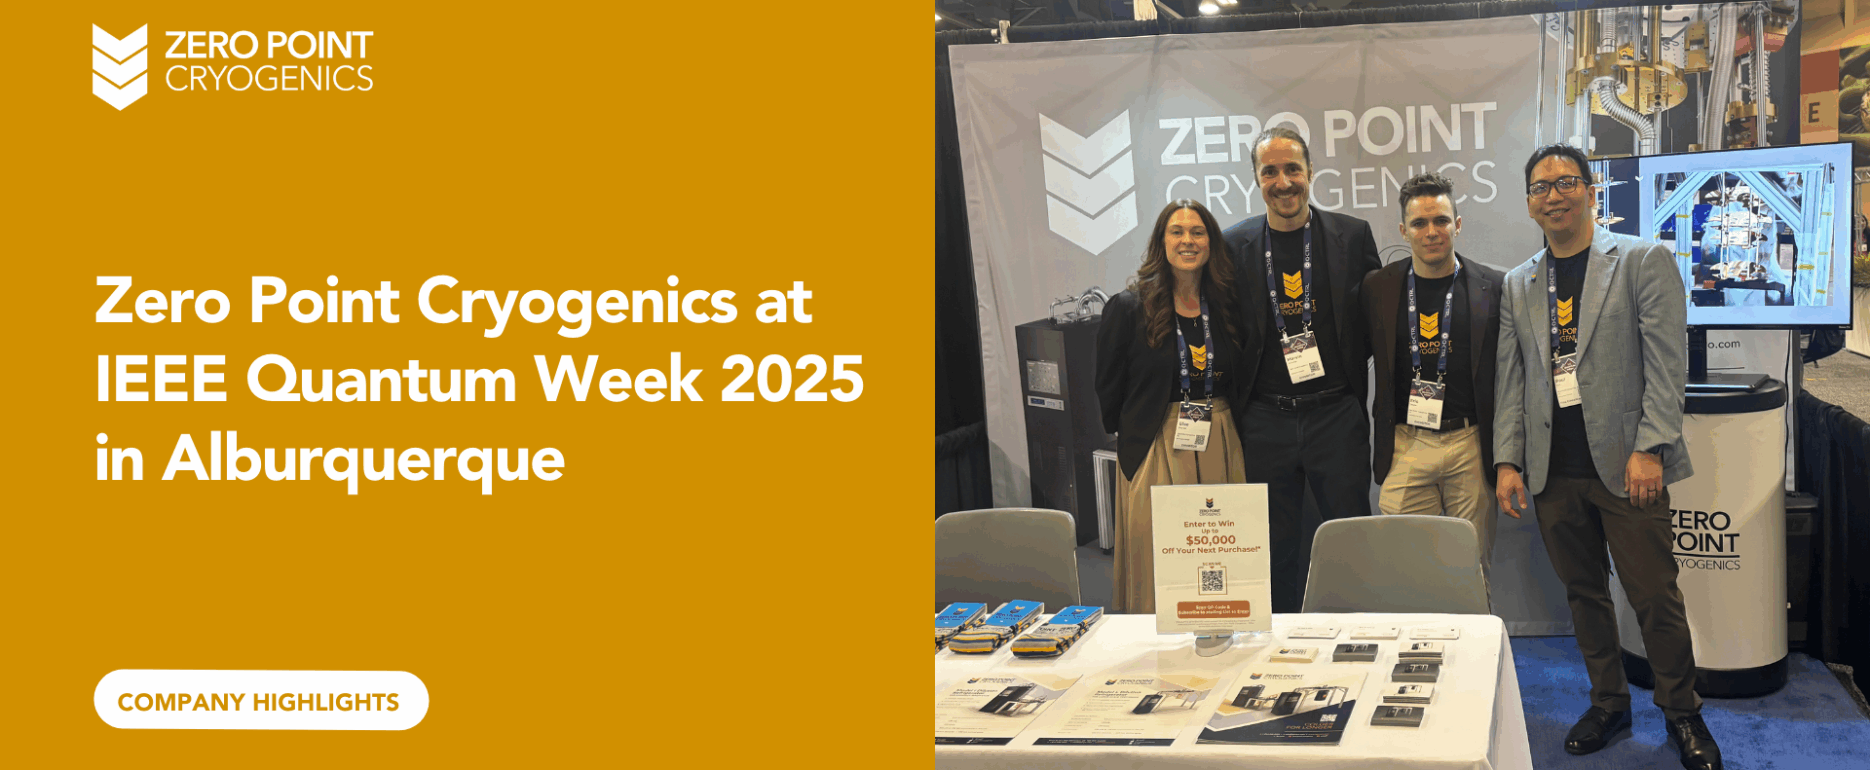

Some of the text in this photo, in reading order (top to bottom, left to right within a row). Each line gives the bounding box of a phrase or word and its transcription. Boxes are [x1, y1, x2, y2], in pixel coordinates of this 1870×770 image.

[1324, 101, 1497, 157] POINT
[1218, 520, 1235, 528] Win
[1186, 535, 1236, 547] $50,000
[1162, 547, 1175, 555] Off
[1675, 557, 1741, 571] YOGENICS
